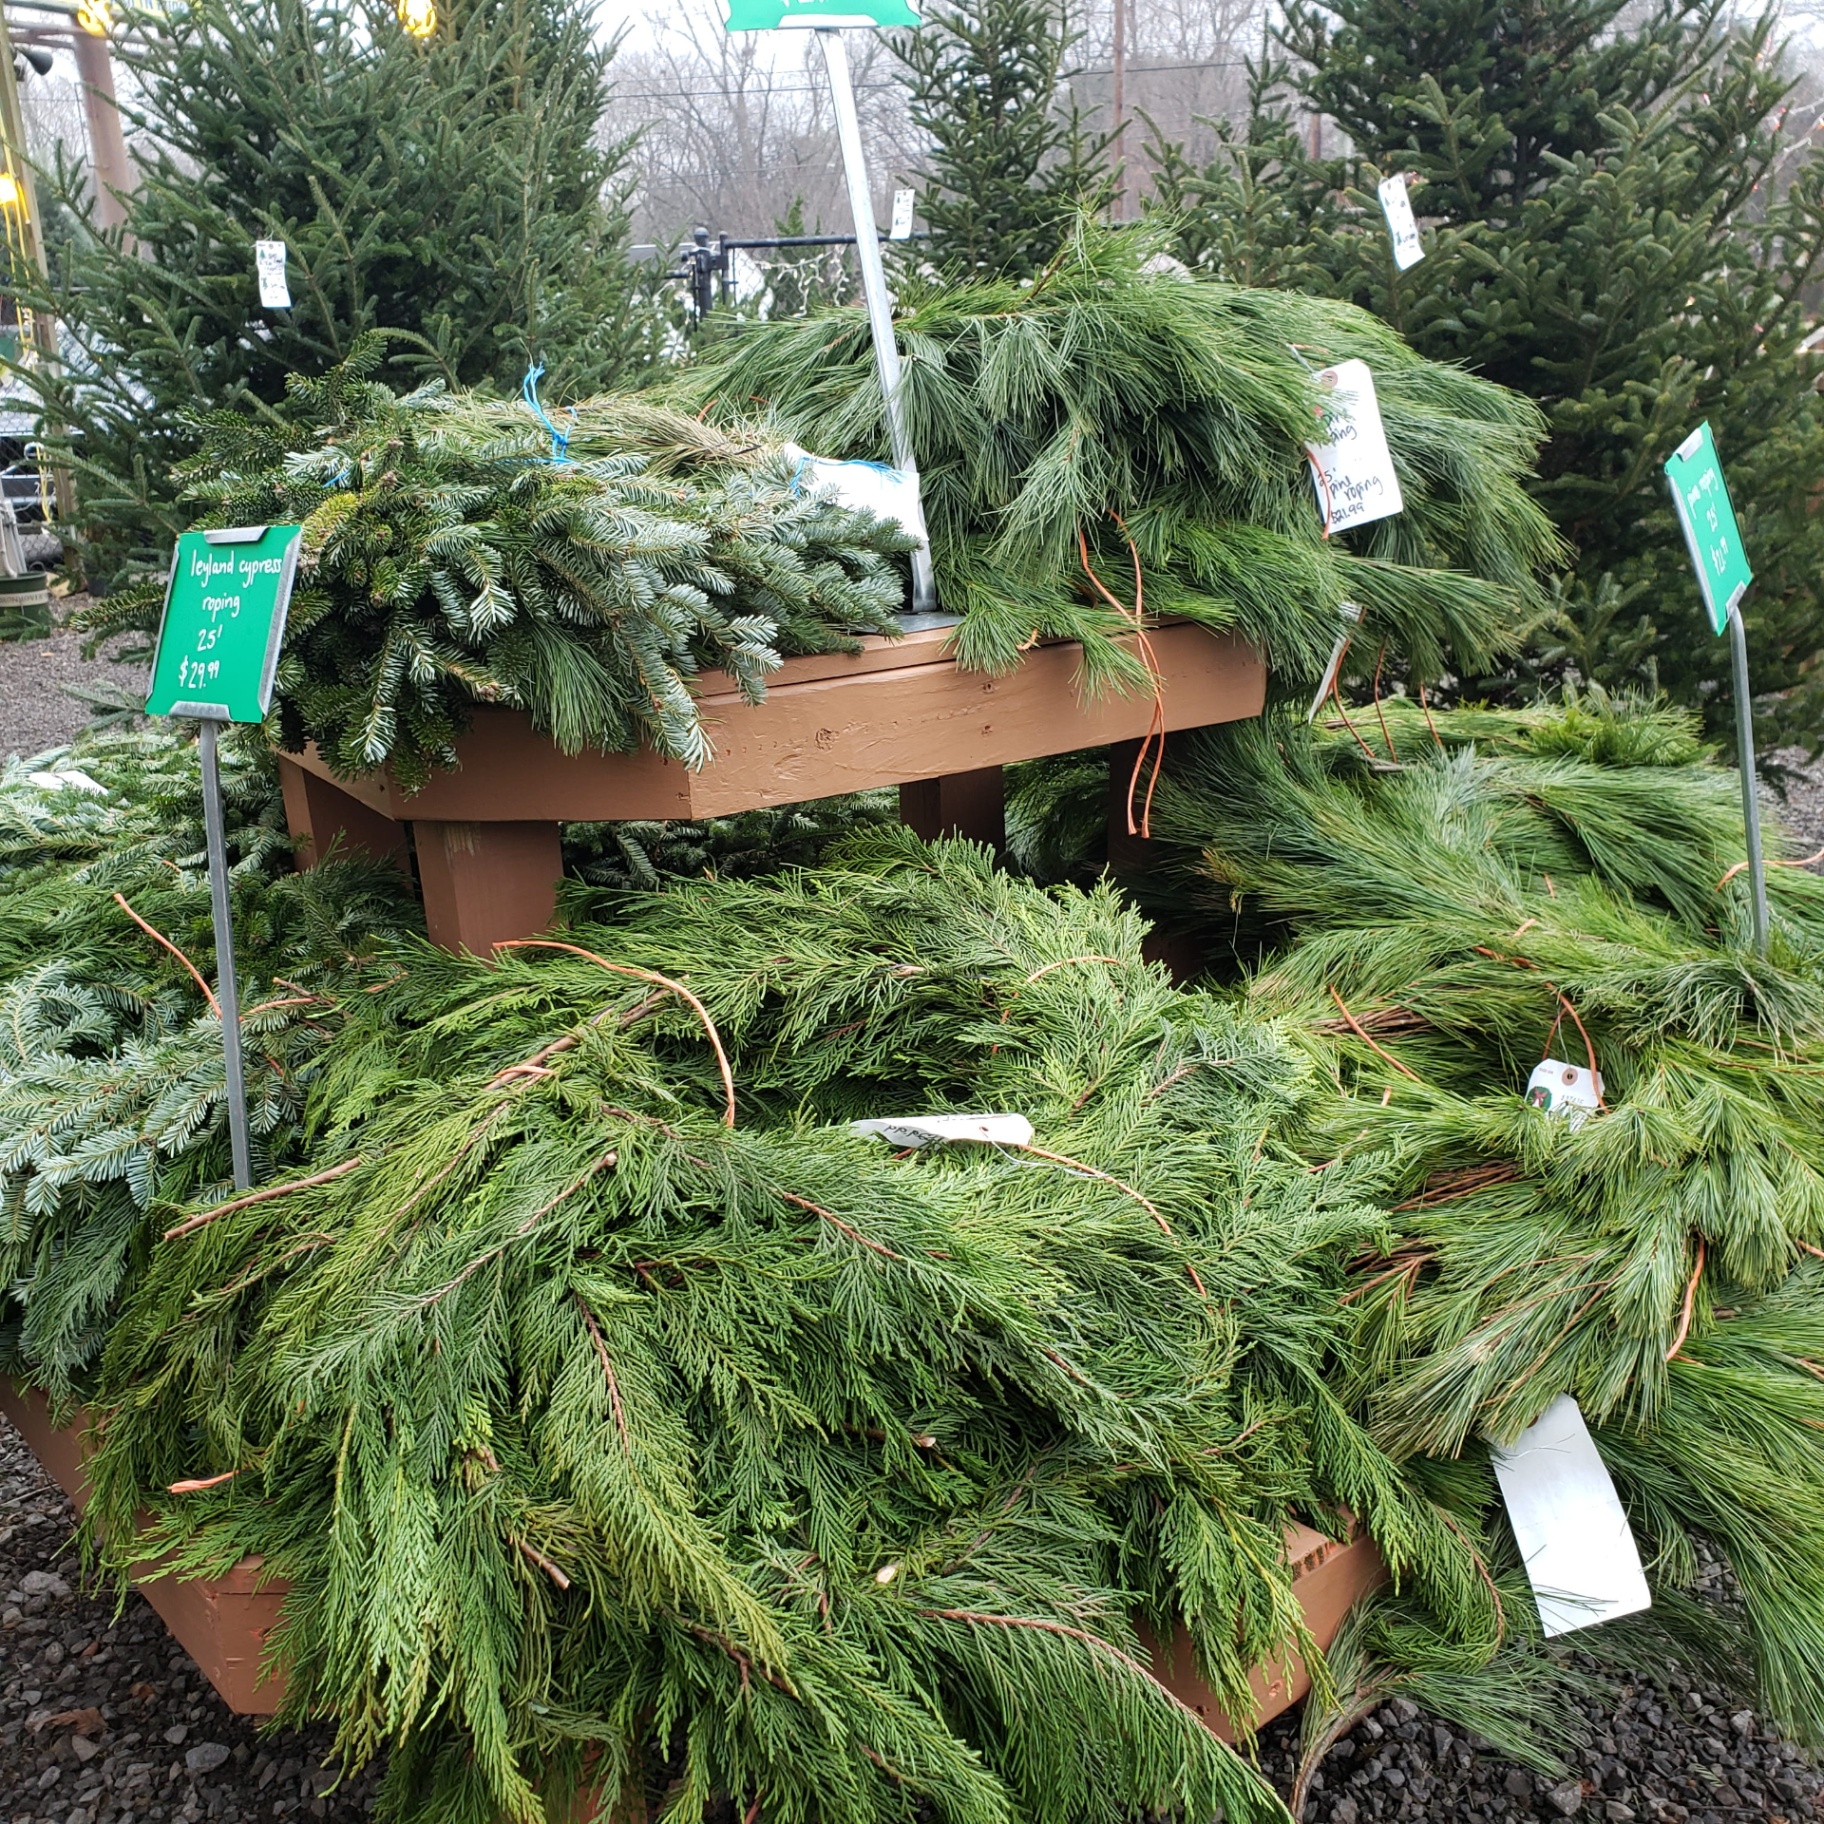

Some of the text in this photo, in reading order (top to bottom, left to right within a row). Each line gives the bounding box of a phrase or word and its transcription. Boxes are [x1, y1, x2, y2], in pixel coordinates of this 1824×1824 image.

[1343, 475, 1384, 501] roping
[1330, 502, 1365, 524] $21.99
[238, 557, 283, 588] cypress
[202, 592, 240, 622] roping
[197, 624, 223, 652] 25'
[178, 655, 220, 689] $29.99
